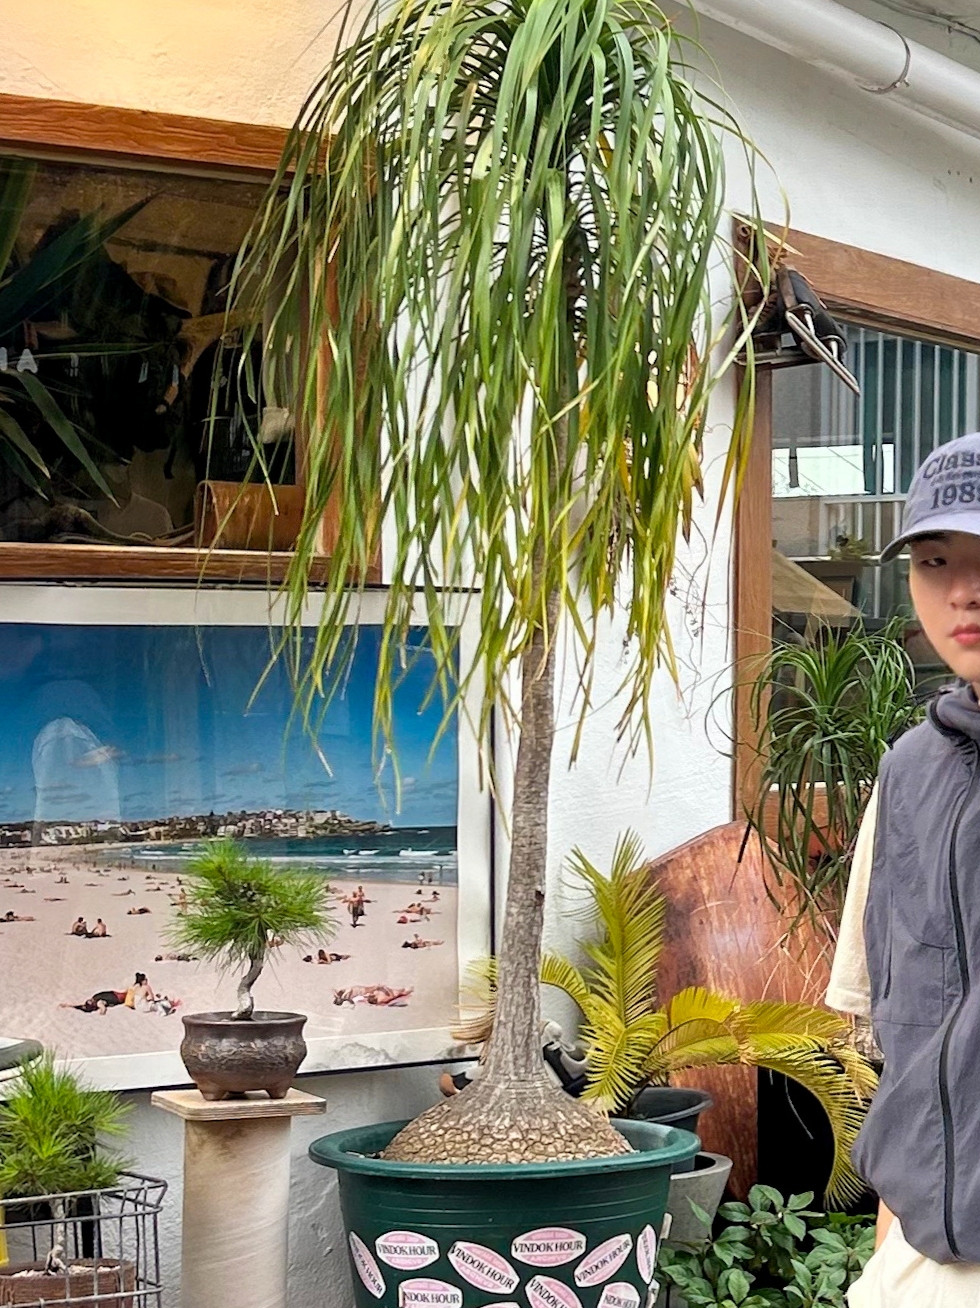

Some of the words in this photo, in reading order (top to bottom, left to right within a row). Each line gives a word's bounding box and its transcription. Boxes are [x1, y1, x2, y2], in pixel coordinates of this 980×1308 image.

[408, 1245, 437, 1256] HOUR
[513, 1242, 553, 1253] VINDOK
[553, 1239, 583, 1251] HOUR
[451, 1244, 486, 1274] VINDOK
[484, 1267, 515, 1290] HOUR
[576, 1255, 609, 1283] VINDOK
[608, 1240, 630, 1262] HOUR
[430, 1293, 460, 1304] HOUR
